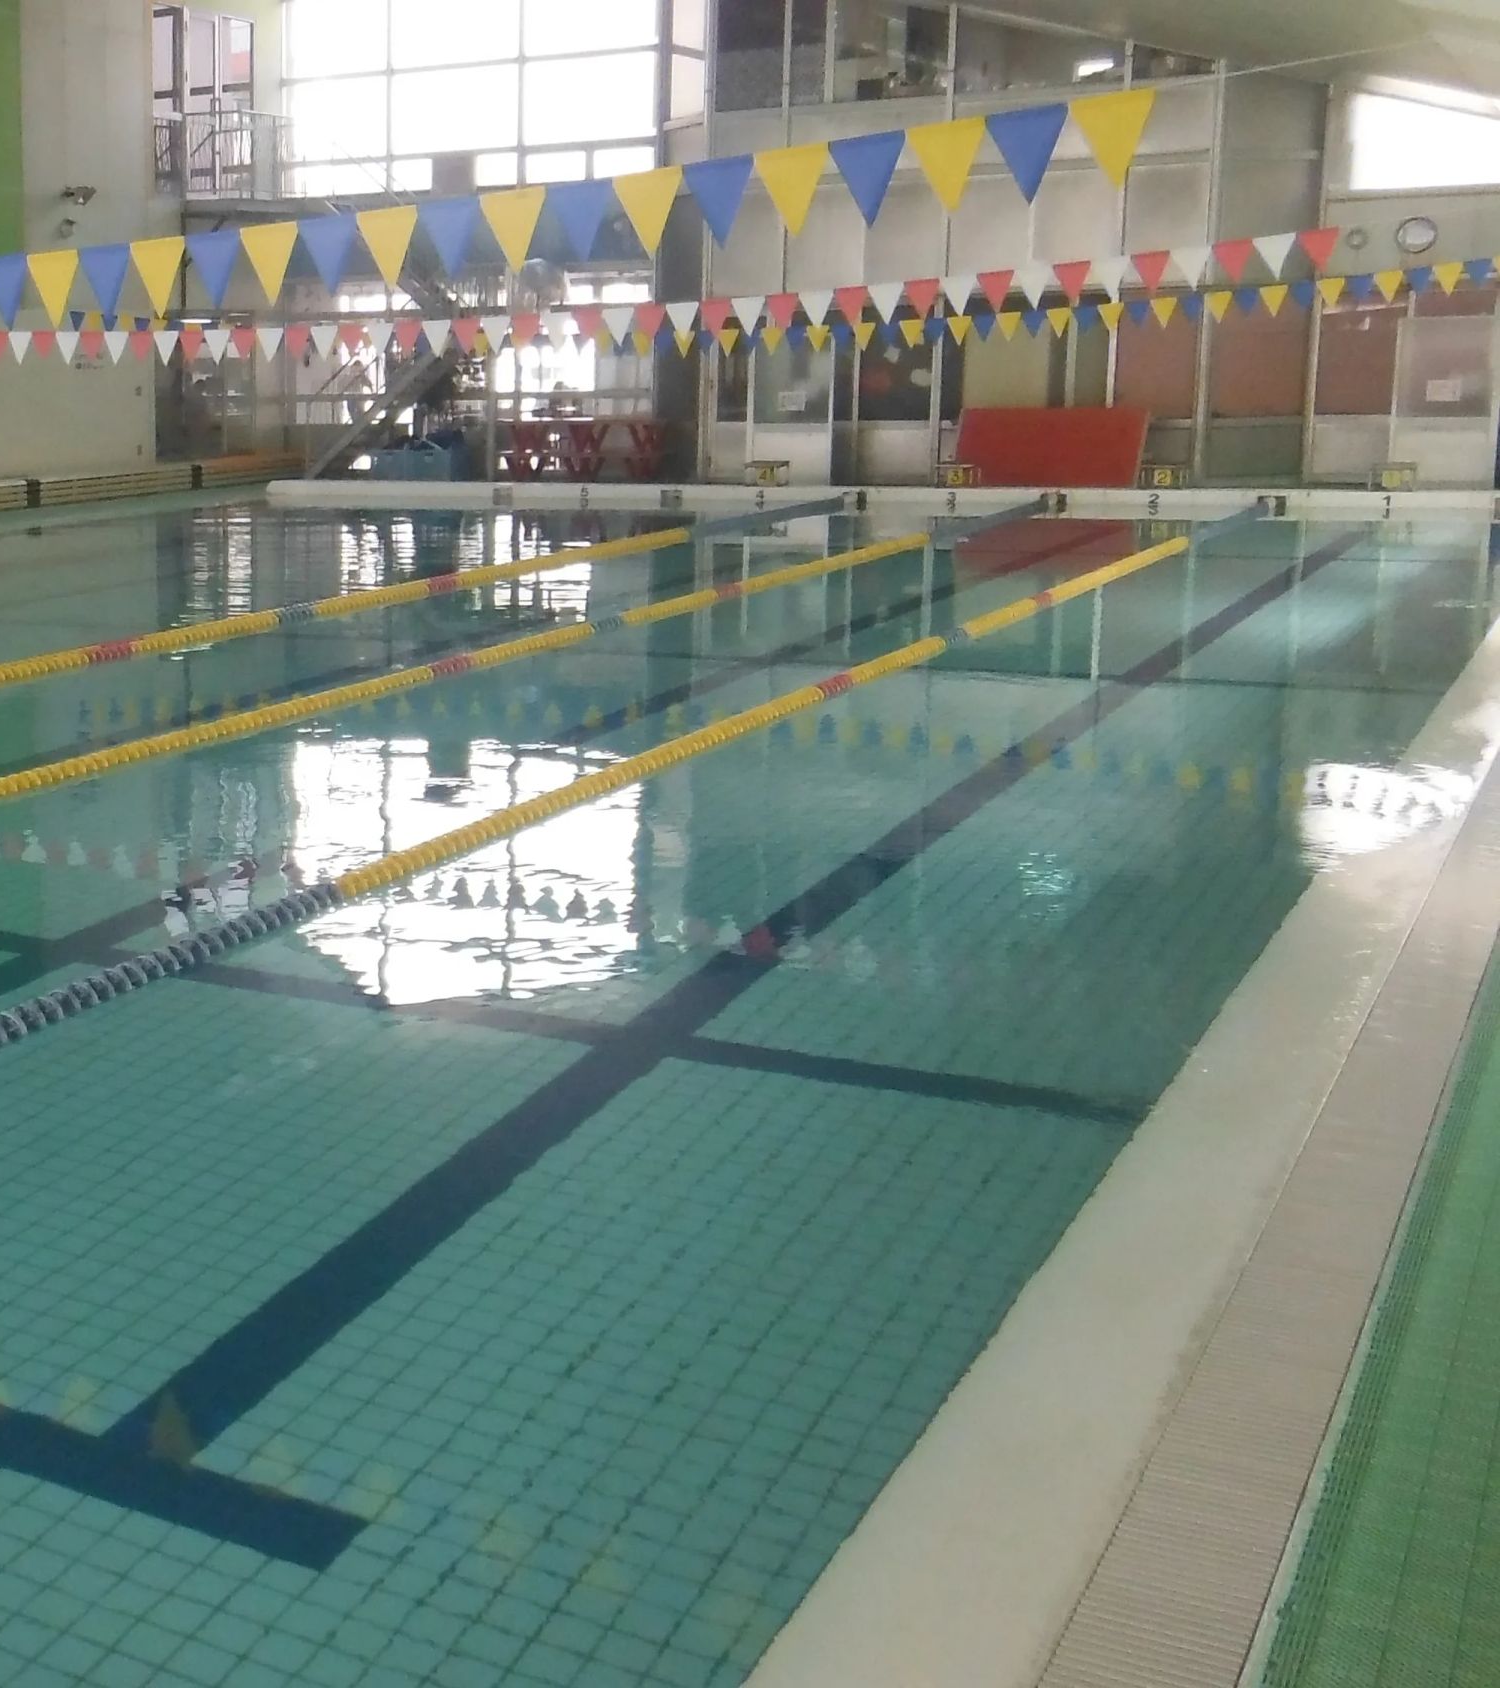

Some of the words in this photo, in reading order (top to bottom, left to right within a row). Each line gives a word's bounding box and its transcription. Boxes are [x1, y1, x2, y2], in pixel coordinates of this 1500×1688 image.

[1157, 471, 1168, 484] 2
[580, 487, 589, 497] 5
[1148, 493, 1160, 505] 2
[1382, 495, 1391, 507] 1
